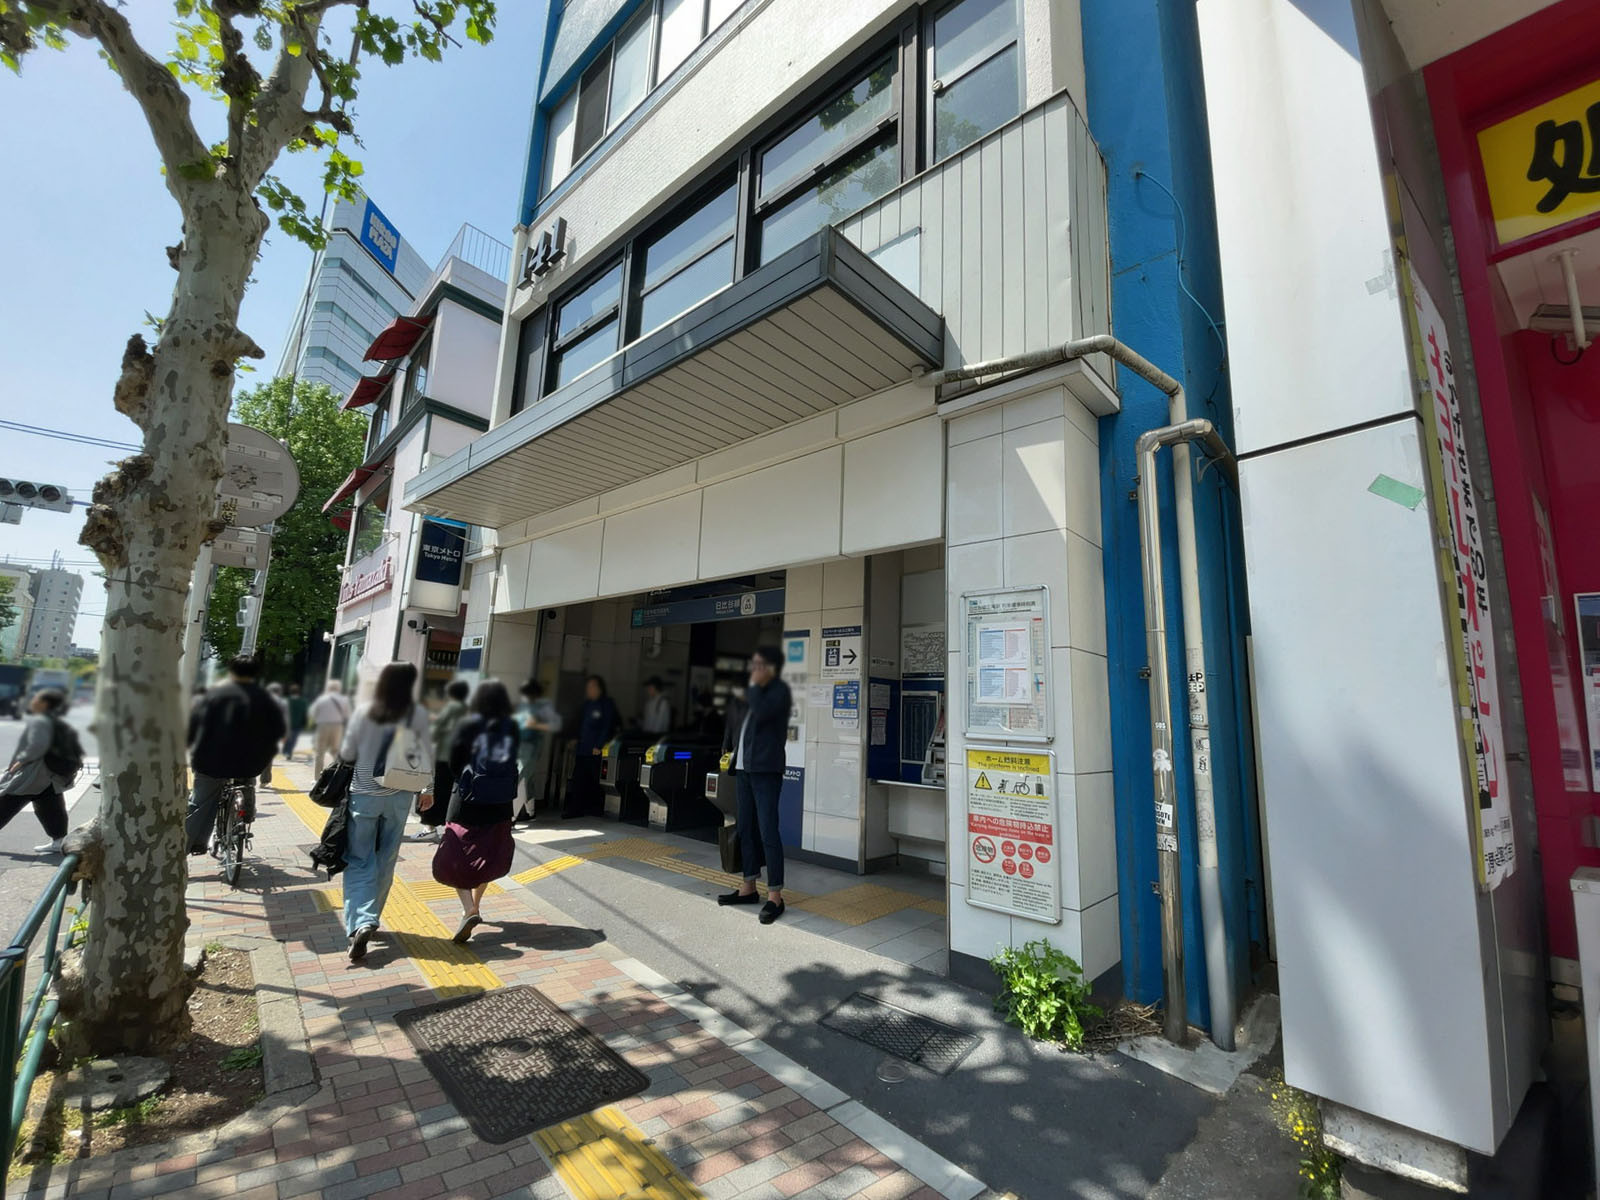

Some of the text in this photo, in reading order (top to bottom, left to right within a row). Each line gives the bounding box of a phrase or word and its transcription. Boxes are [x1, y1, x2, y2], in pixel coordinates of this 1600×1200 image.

[516, 216, 568, 291] 141
[422, 544, 461, 558] 東京メトロ
[424, 551, 440, 561] Tokyo
